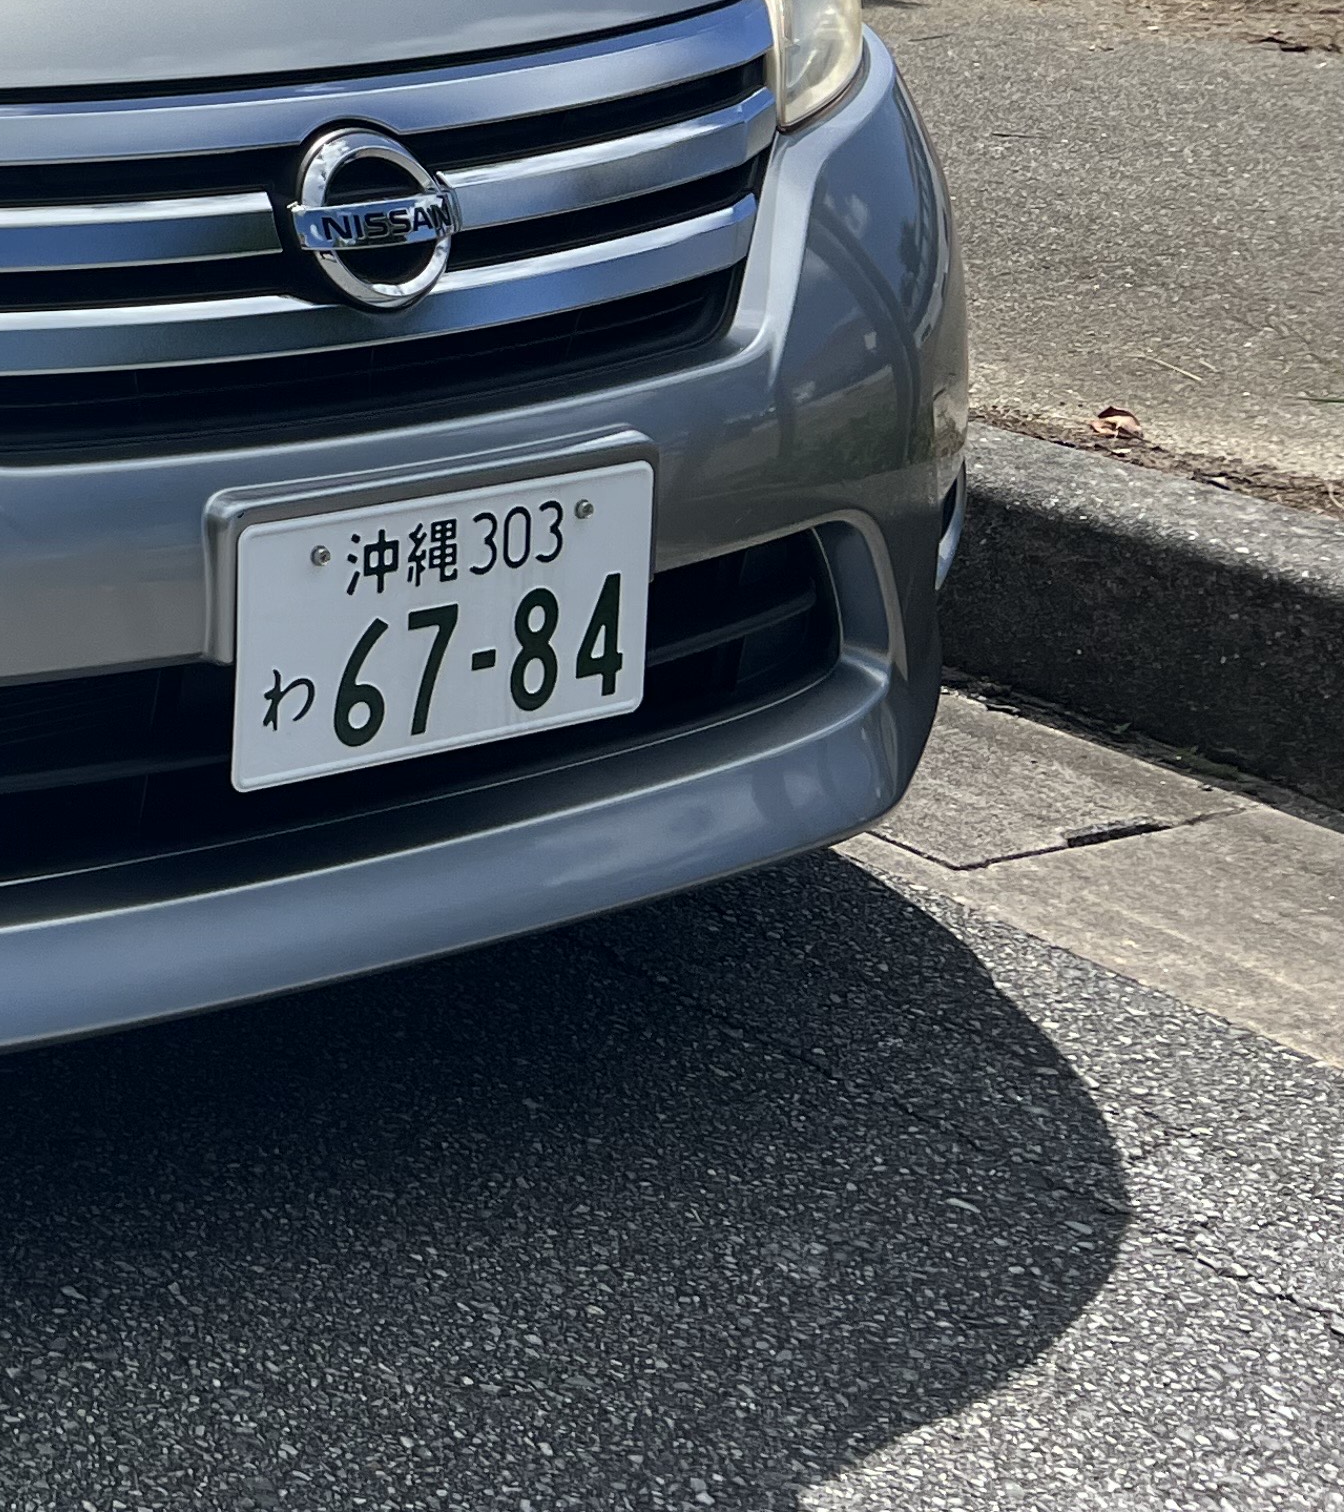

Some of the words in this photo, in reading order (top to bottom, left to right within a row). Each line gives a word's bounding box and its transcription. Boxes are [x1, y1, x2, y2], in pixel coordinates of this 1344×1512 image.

[321, 195, 451, 240] NISSAN
[262, 668, 316, 732] わ
[333, 572, 624, 748] 67-84
